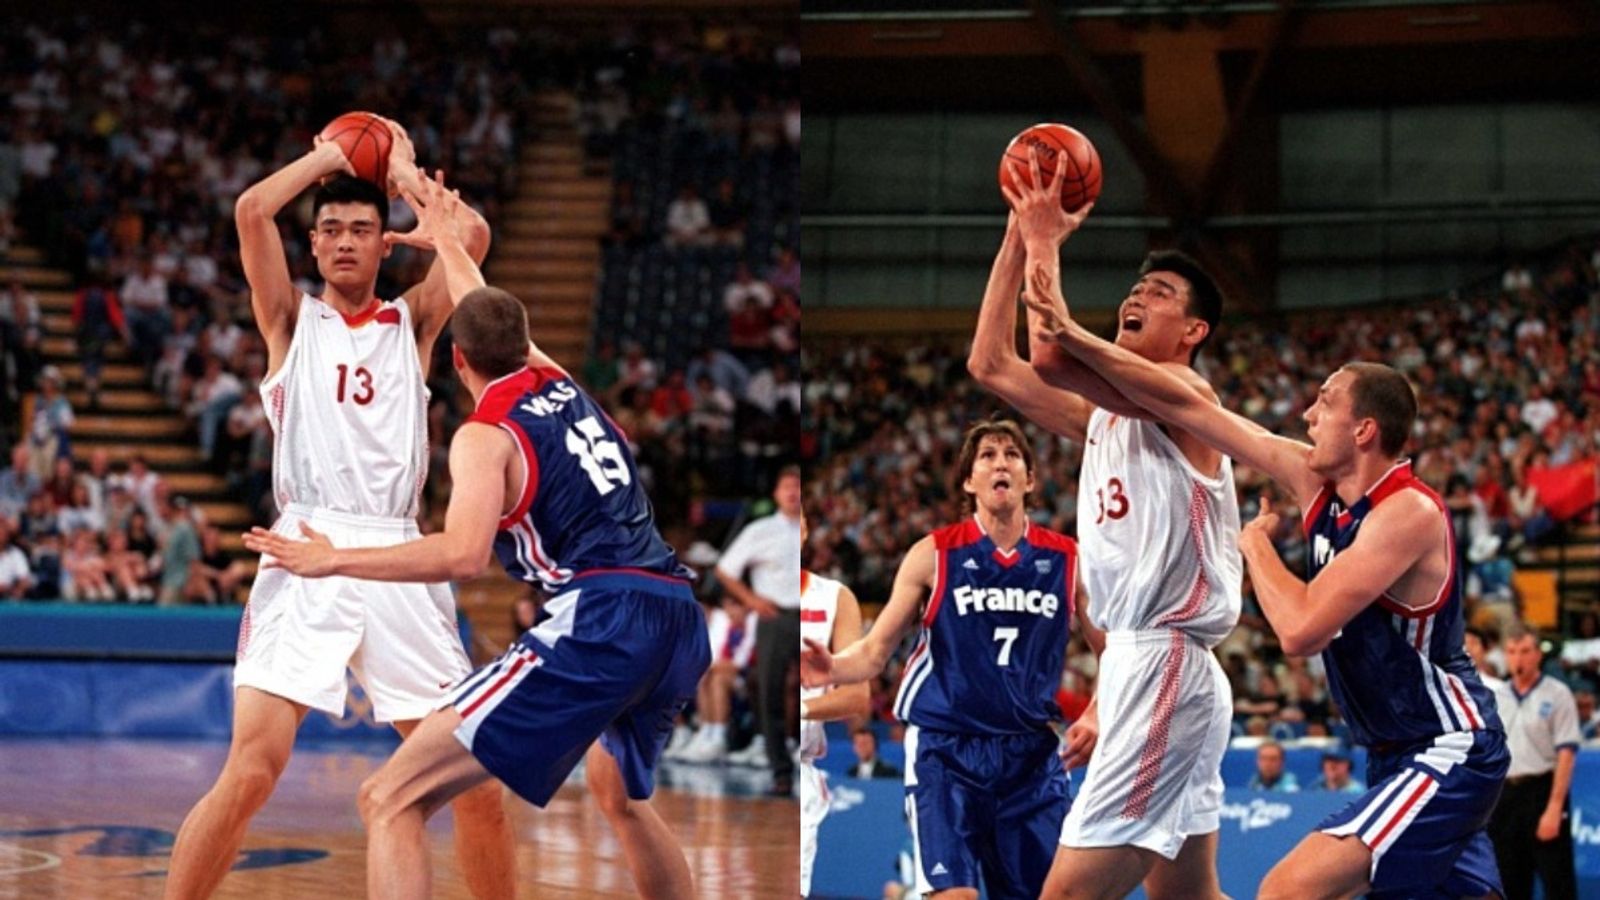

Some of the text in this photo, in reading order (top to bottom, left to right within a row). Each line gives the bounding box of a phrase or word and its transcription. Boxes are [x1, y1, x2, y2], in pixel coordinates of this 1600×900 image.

[336, 363, 375, 406] 13
[565, 416, 631, 496] 15
[953, 585, 1058, 619] France
[993, 627, 1019, 666] 7
